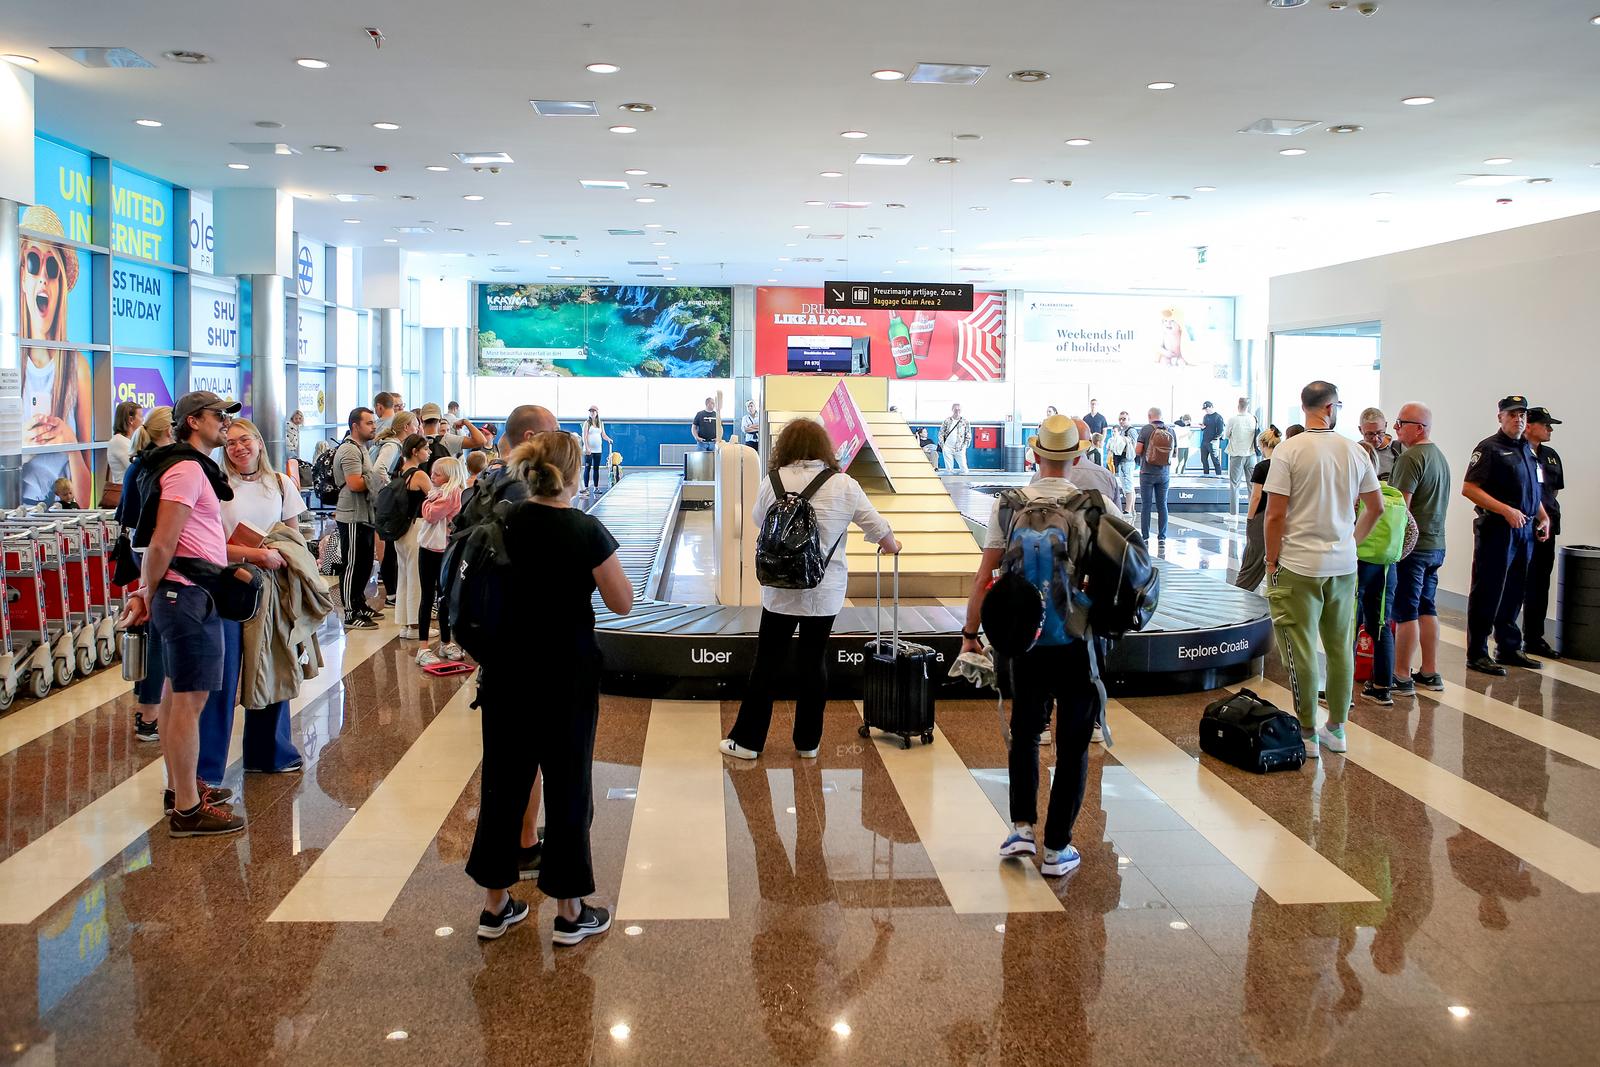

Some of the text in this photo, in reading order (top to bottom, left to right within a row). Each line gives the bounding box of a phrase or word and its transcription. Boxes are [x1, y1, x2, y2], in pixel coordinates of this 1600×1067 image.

[129, 273, 161, 297] THAN
[873, 287, 911, 297] Preuzimanje
[912, 288, 939, 297] prtljage,
[873, 297, 900, 306] Baggage
[774, 313, 868, 326] LIKE A LOCAL.
[1057, 329, 1134, 341] Weekends full
[1056, 341, 1121, 356] of holidays!
[194, 377, 233, 394] NOVALJA
[138, 392, 155, 409] EUR
[1178, 491, 1194, 500] Uber
[691, 648, 732, 664] Uber
[1178, 638, 1249, 661] Explore Croatia
